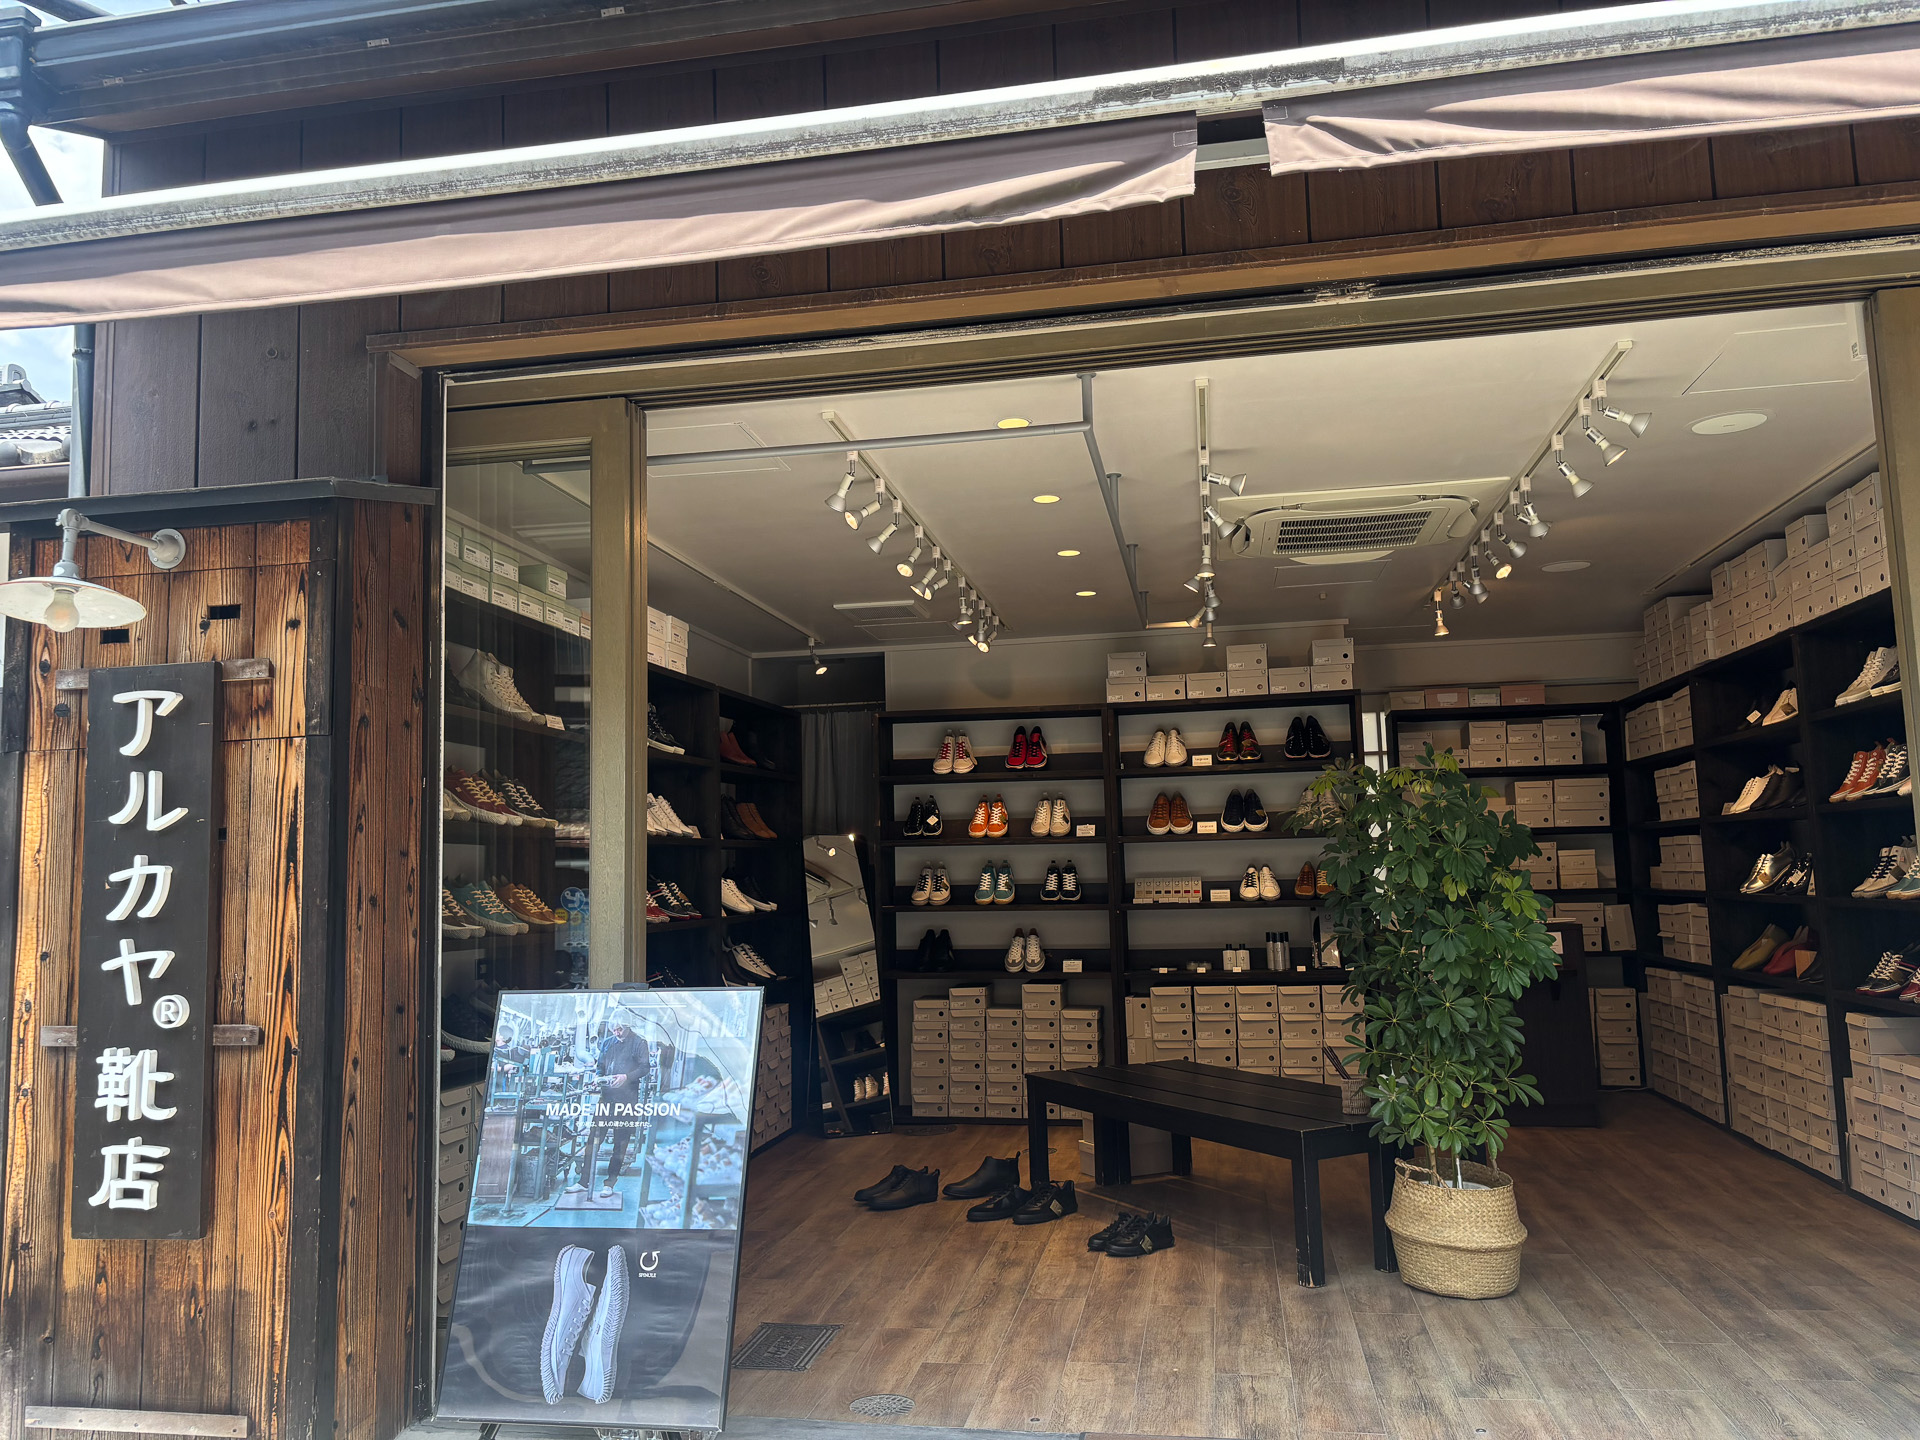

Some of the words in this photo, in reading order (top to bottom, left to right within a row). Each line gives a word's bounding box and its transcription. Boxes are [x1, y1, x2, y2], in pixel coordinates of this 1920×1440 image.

[545, 1102, 592, 1117] MADE
[594, 1102, 611, 1117] IN
[614, 1102, 681, 1117] PASSION
